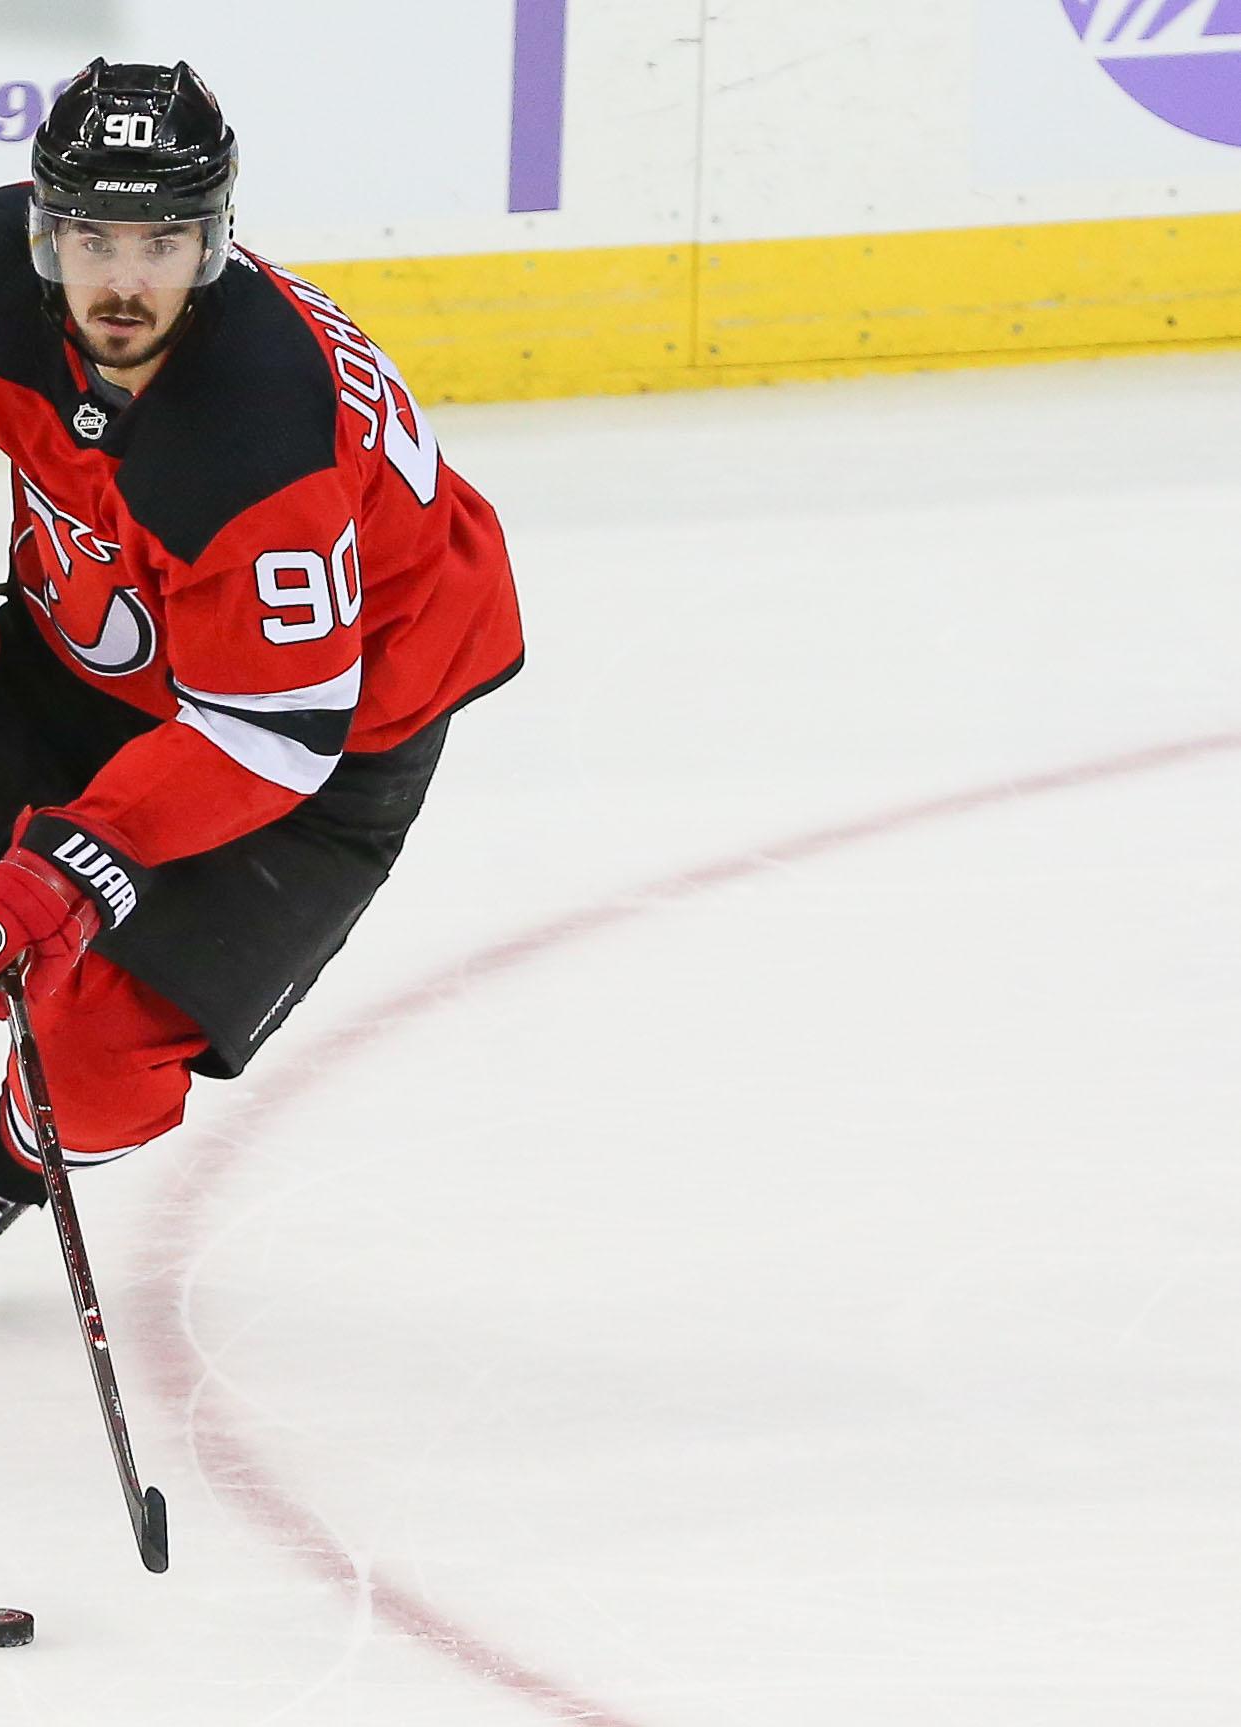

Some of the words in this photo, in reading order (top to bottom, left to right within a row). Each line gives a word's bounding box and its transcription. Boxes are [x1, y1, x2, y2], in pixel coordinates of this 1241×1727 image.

[102, 113, 154, 148] 90
[93, 180, 158, 193] BAUER
[254, 255, 382, 452] JOHA
[254, 516, 363, 646] 90
[51, 831, 138, 930] WAR
